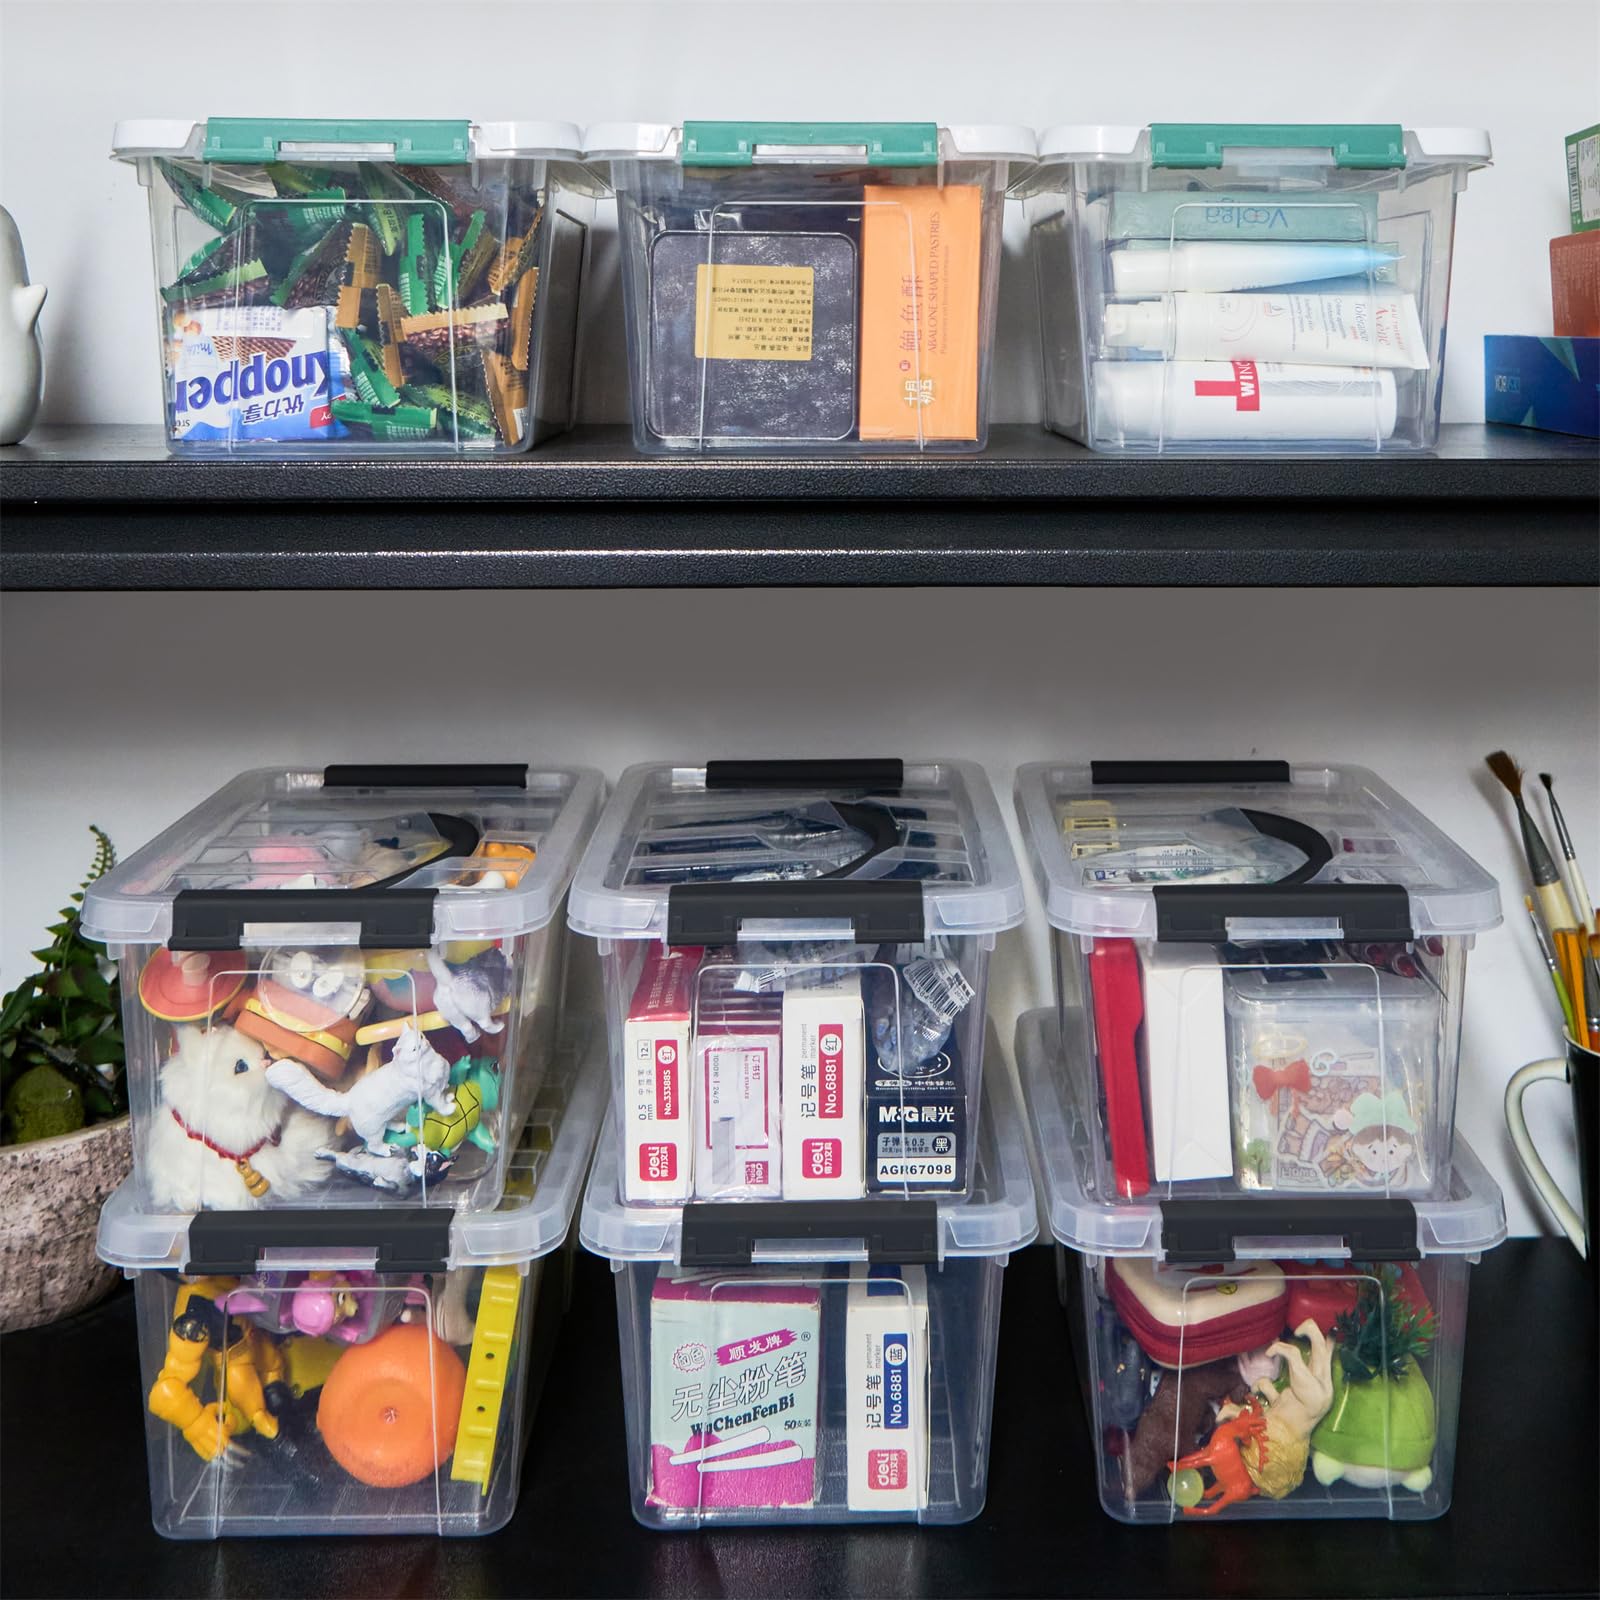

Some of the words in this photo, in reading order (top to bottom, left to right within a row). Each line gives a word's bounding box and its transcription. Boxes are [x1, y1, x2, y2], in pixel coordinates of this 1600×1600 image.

[243, 394, 304, 424] 优力享
[800, 1023, 808, 1059] permanent
[824, 1037, 837, 1051] 红
[752, 1055, 761, 1080] 订书钉
[800, 1063, 817, 1118] 记号笔
[824, 1059, 837, 1114] No.6881
[638, 1104, 647, 1120] 0.5
[646, 1103, 653, 1120] mm
[879, 1106, 919, 1123] M&G
[921, 1106, 955, 1123] 晨光
[811, 1141, 823, 1175] deli
[911, 1137, 925, 1147] 0.5
[935, 1137, 948, 1152] 黑
[648, 1146, 660, 1178] deli
[755, 1162, 764, 1184] deli
[880, 1165, 952, 1175] AGR67098
[865, 1333, 873, 1369] permanent
[671, 1351, 807, 1423] 无尘粉笔
[866, 1374, 882, 1428] 记号笔
[890, 1369, 902, 1424] No.6881
[690, 1392, 795, 1436] WuChenFenBi
[877, 1452, 889, 1486] deli
